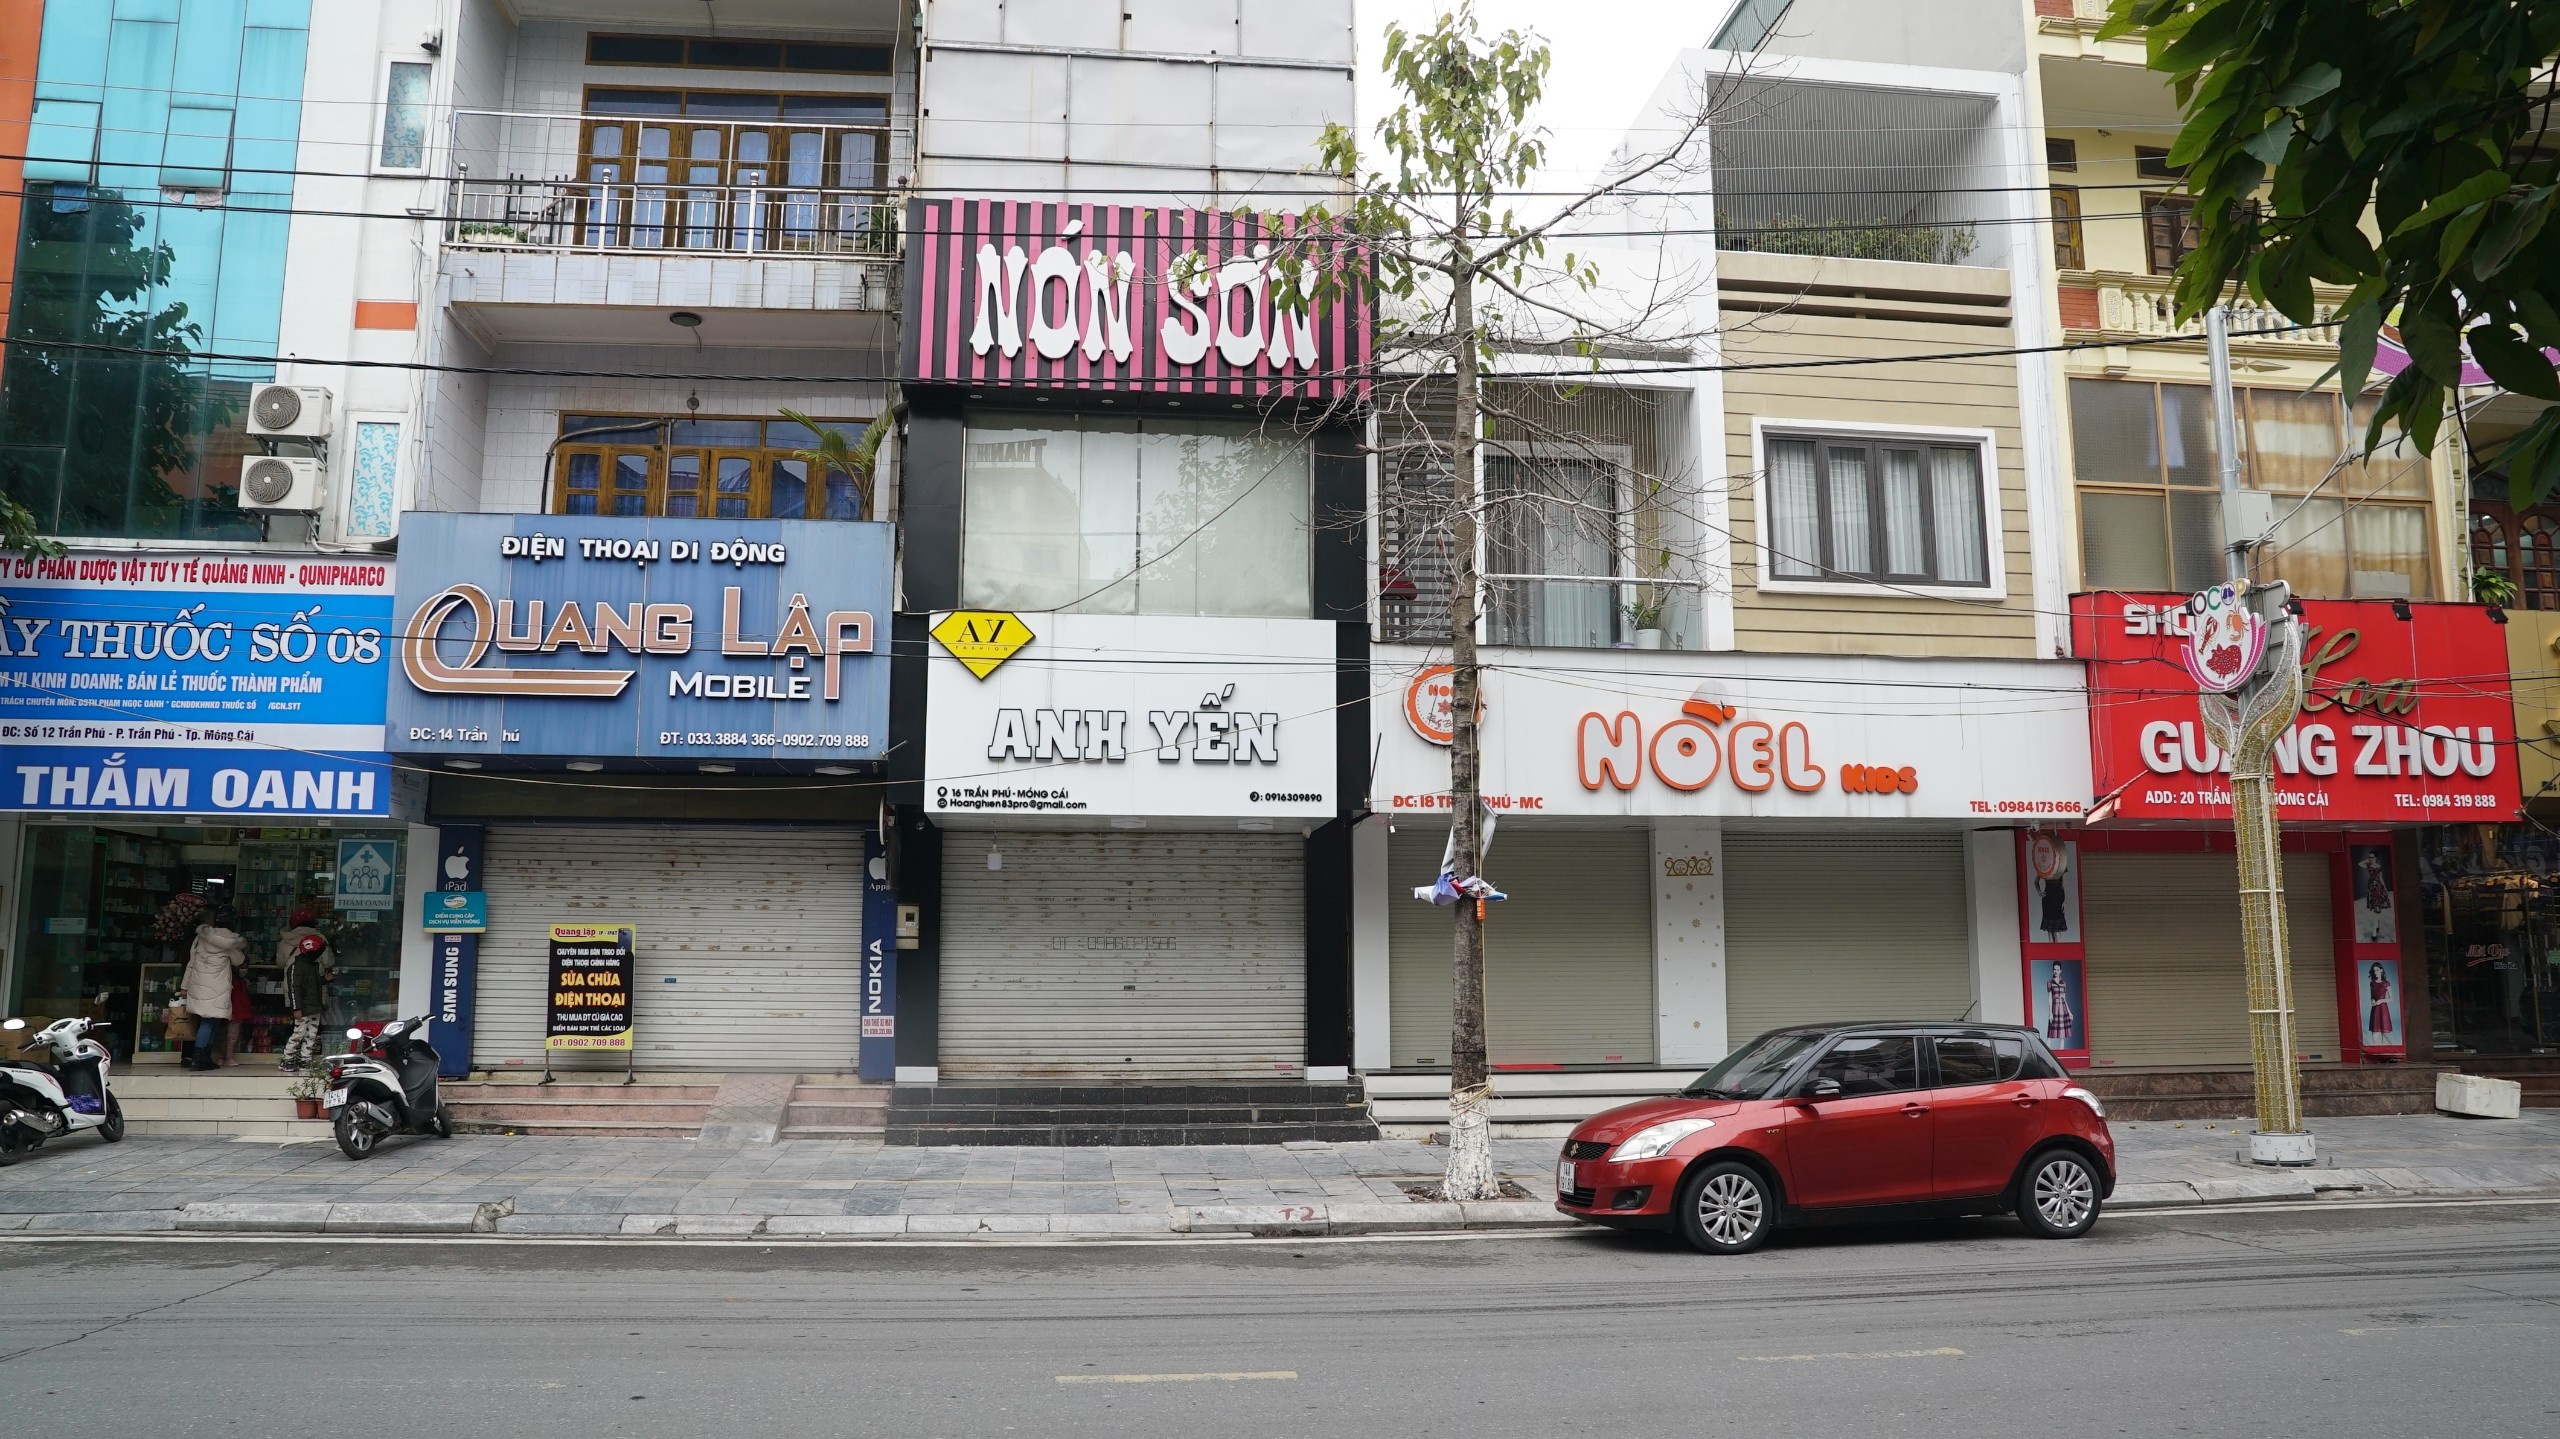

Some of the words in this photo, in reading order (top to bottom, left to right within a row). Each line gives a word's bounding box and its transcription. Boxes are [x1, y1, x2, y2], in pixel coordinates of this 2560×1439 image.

[969, 219, 1137, 364] NÓN
[1160, 243, 1321, 371] SƠN
[501, 531, 566, 562] ĐIỆN
[579, 536, 661, 568] THOẠI
[670, 539, 699, 563] DI
[710, 536, 787, 569] ĐỘNG
[121, 557, 147, 586] VẬT
[171, 562, 180, 583] Y
[183, 556, 201, 583] TẾ
[202, 556, 248, 585] QUẢNG
[252, 564, 286, 585] NINH
[299, 564, 386, 587] QUNIPHARCO
[60, 602, 235, 662] THUỐC
[249, 604, 323, 663] SỐ
[326, 627, 382, 665] 08
[31, 671, 67, 689] KINH
[70, 672, 123, 690] DOANH:
[127, 671, 157, 690] BÁN
[160, 669, 178, 691] LẺ
[181, 669, 227, 692] THUỐC
[231, 673, 277, 693] THÀNH
[280, 671, 323, 693] PHẨM
[668, 669, 812, 701] MOBILE
[2, 726, 21, 738] ĐC:
[42, 727, 55, 738] 12
[58, 726, 82, 739] Trần
[84, 727, 106, 739] Phú
[116, 728, 125, 739] P.
[129, 726, 151, 740] Trần
[154, 728, 175, 740] Phú
[409, 727, 436, 741] ĐC:
[438, 728, 454, 741] 14
[457, 725, 489, 742] Trần
[986, 708, 1128, 763] ANH
[1148, 682, 1280, 764] YẾN
[659, 731, 684, 746] ĐT:
[687, 731, 748, 746] 033.3884
[844, 734, 870, 748] 888
[2140, 720, 2339, 776] GUNG
[2353, 724, 2497, 777] ZHOU
[16, 751, 191, 809] THẮM
[211, 768, 376, 811] OANH
[1840, 763, 1919, 794] KIDS
[951, 788, 962, 798] 16
[964, 785, 989, 798] TRẦN
[991, 786, 1012, 798] PHÚ
[1017, 786, 1049, 799] MÓNG
[1050, 786, 1069, 799] CÁI
[1393, 795, 1418, 808] ĐC:
[2145, 790, 2177, 804] ADD:
[2179, 791, 2195, 805] 20
[2307, 789, 2330, 807] CÁI
[2394, 793, 2421, 807] TEL:
[2422, 794, 2451, 807] 0984
[2453, 794, 2473, 807] 319
[2474, 794, 2497, 807] 888
[445, 881, 467, 892] iPad
[555, 927, 581, 937] Quang
[442, 946, 460, 1023] SAMSUNG
[561, 969, 585, 987] SỬA
[587, 970, 621, 987] CHỮA
[868, 938, 883, 1014] NOKIA
[555, 990, 584, 1008] ĐIỆN
[586, 992, 626, 1008] THOẠI
[567, 1038, 626, 1047] 0902.709.888
